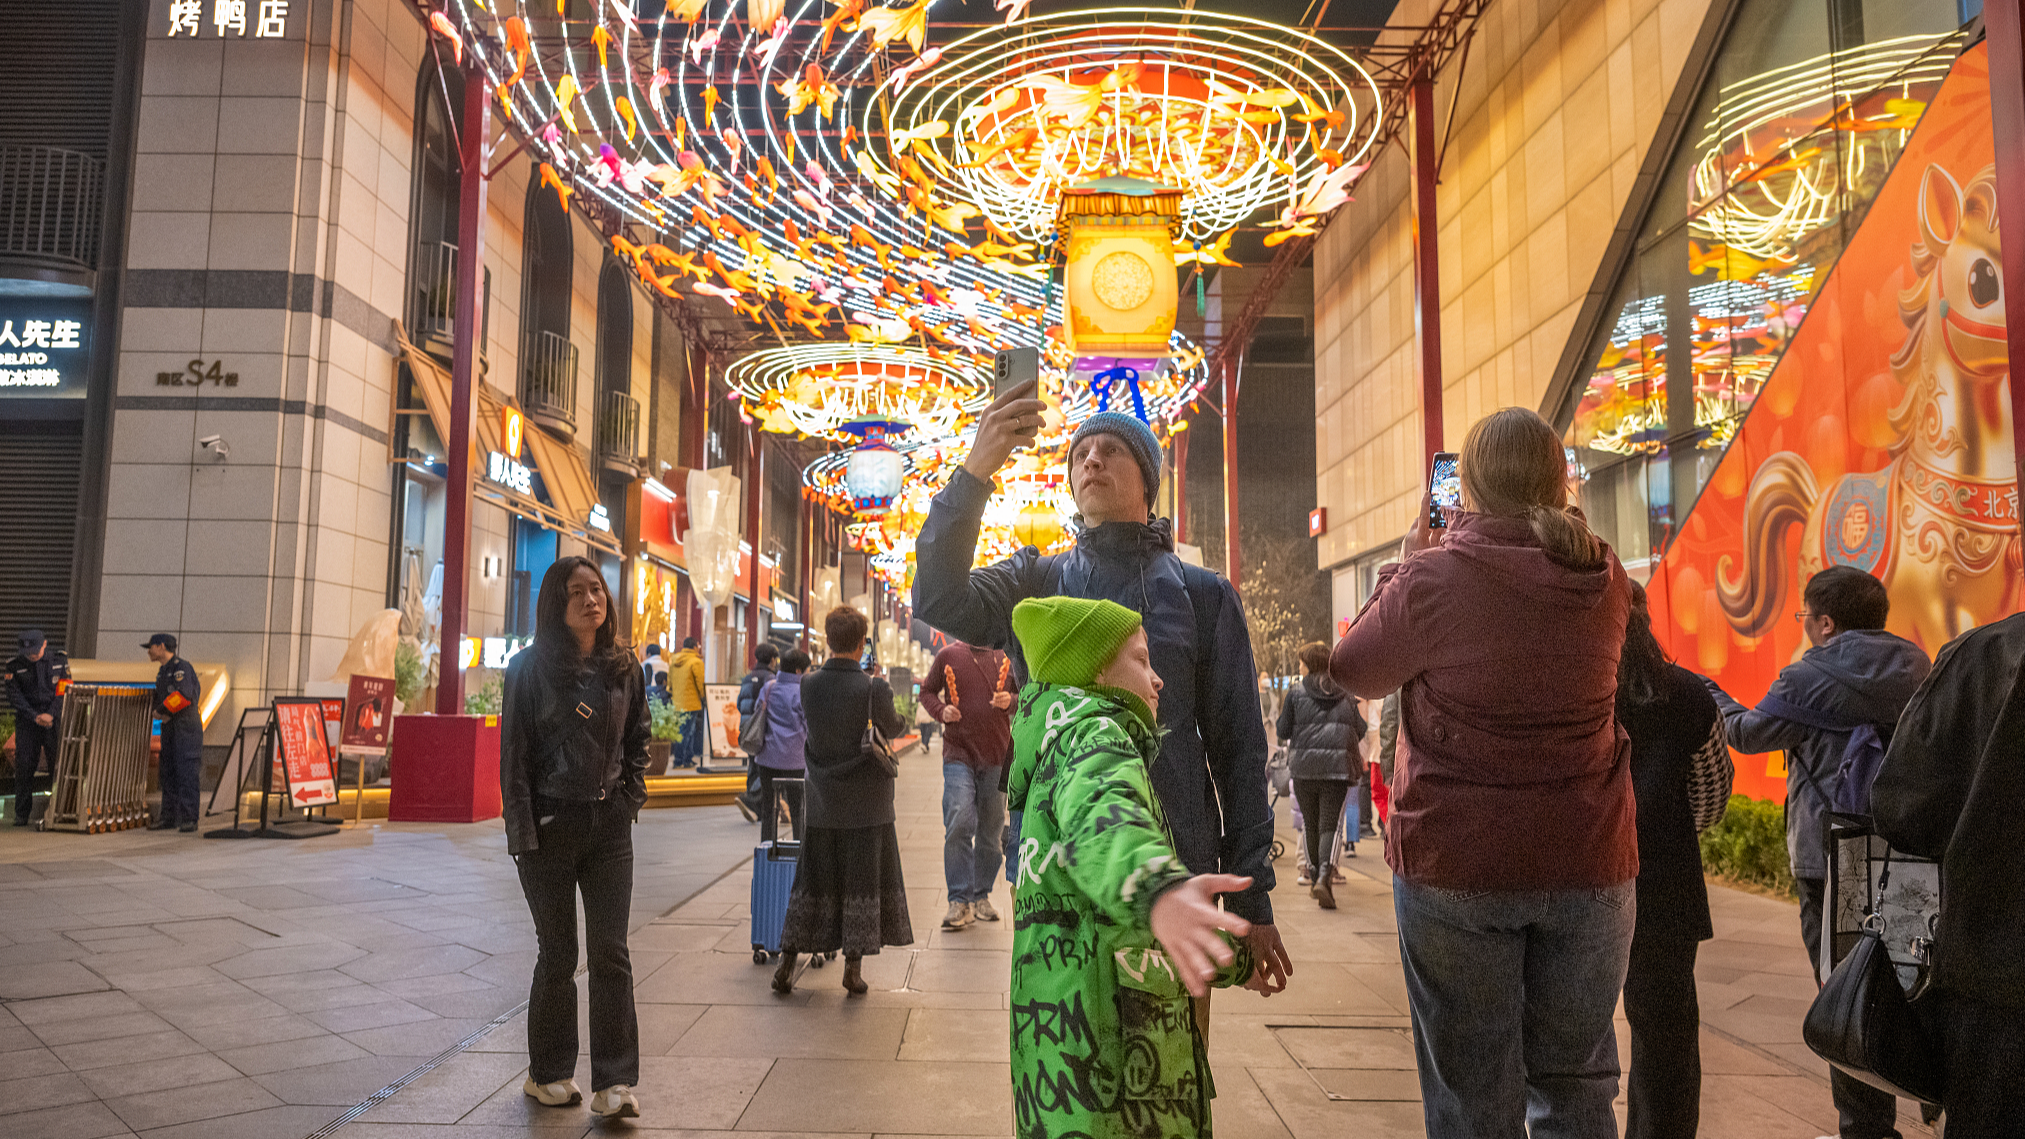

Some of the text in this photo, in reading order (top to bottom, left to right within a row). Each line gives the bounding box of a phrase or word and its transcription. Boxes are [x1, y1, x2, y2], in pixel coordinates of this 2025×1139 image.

[168, 0, 289, 38] 烤鸭店
[1983, 486, 2019, 520] 北京
[1842, 501, 1869, 549] 福
